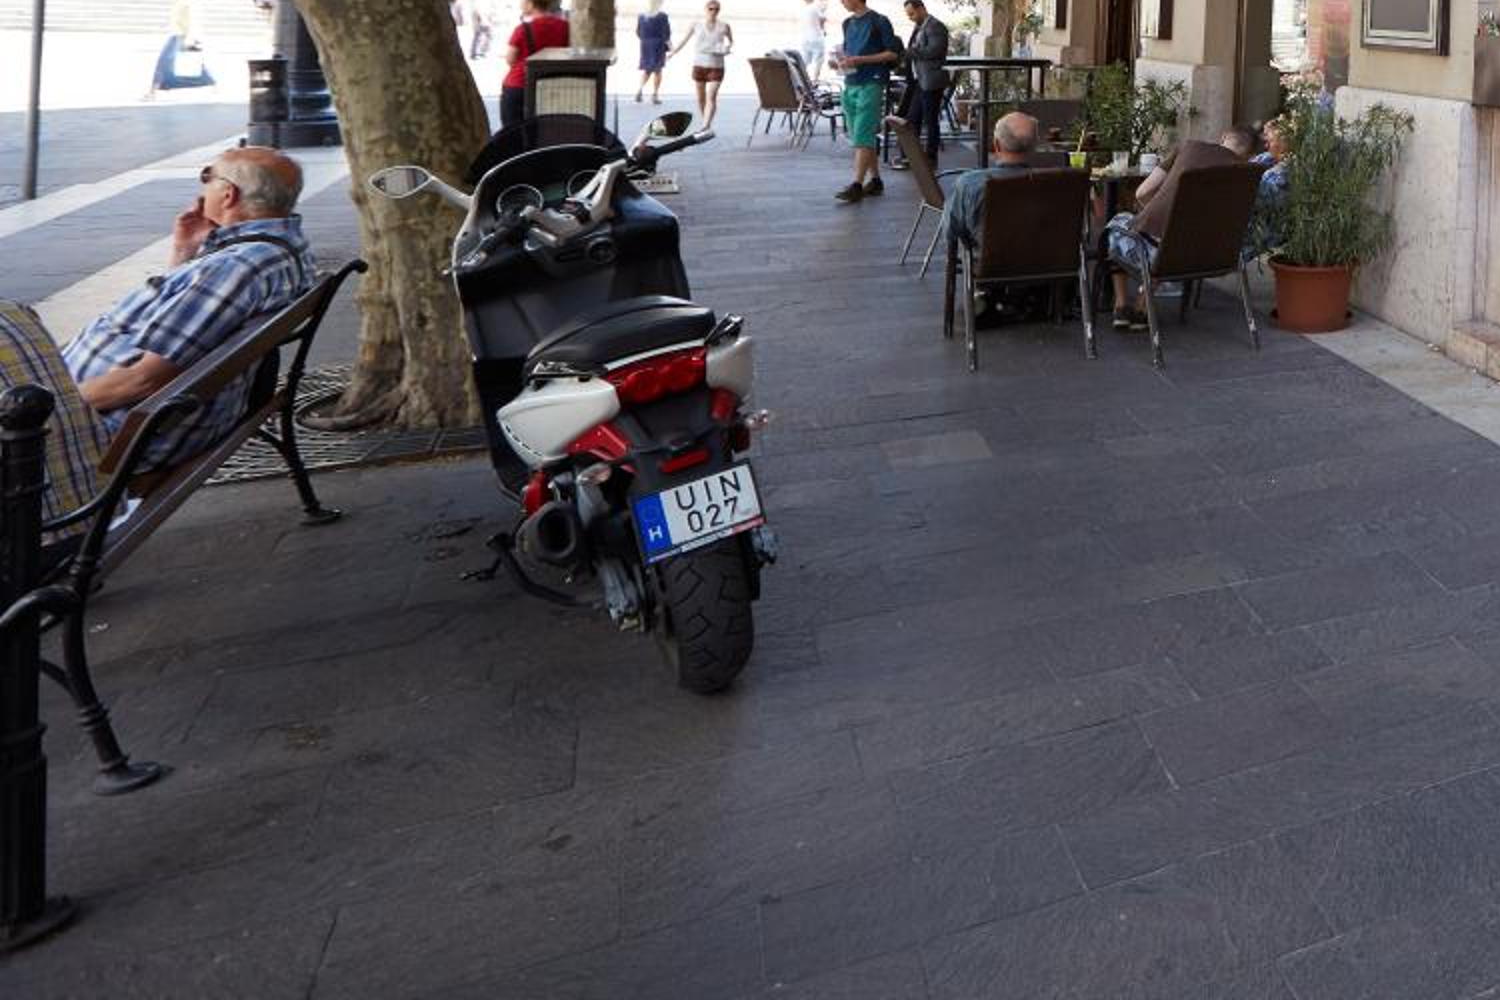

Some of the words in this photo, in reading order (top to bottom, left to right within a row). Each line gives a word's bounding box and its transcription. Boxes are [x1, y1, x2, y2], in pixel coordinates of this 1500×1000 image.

[674, 471, 741, 510] UIN
[648, 525, 663, 542] H
[687, 496, 738, 533] 027
